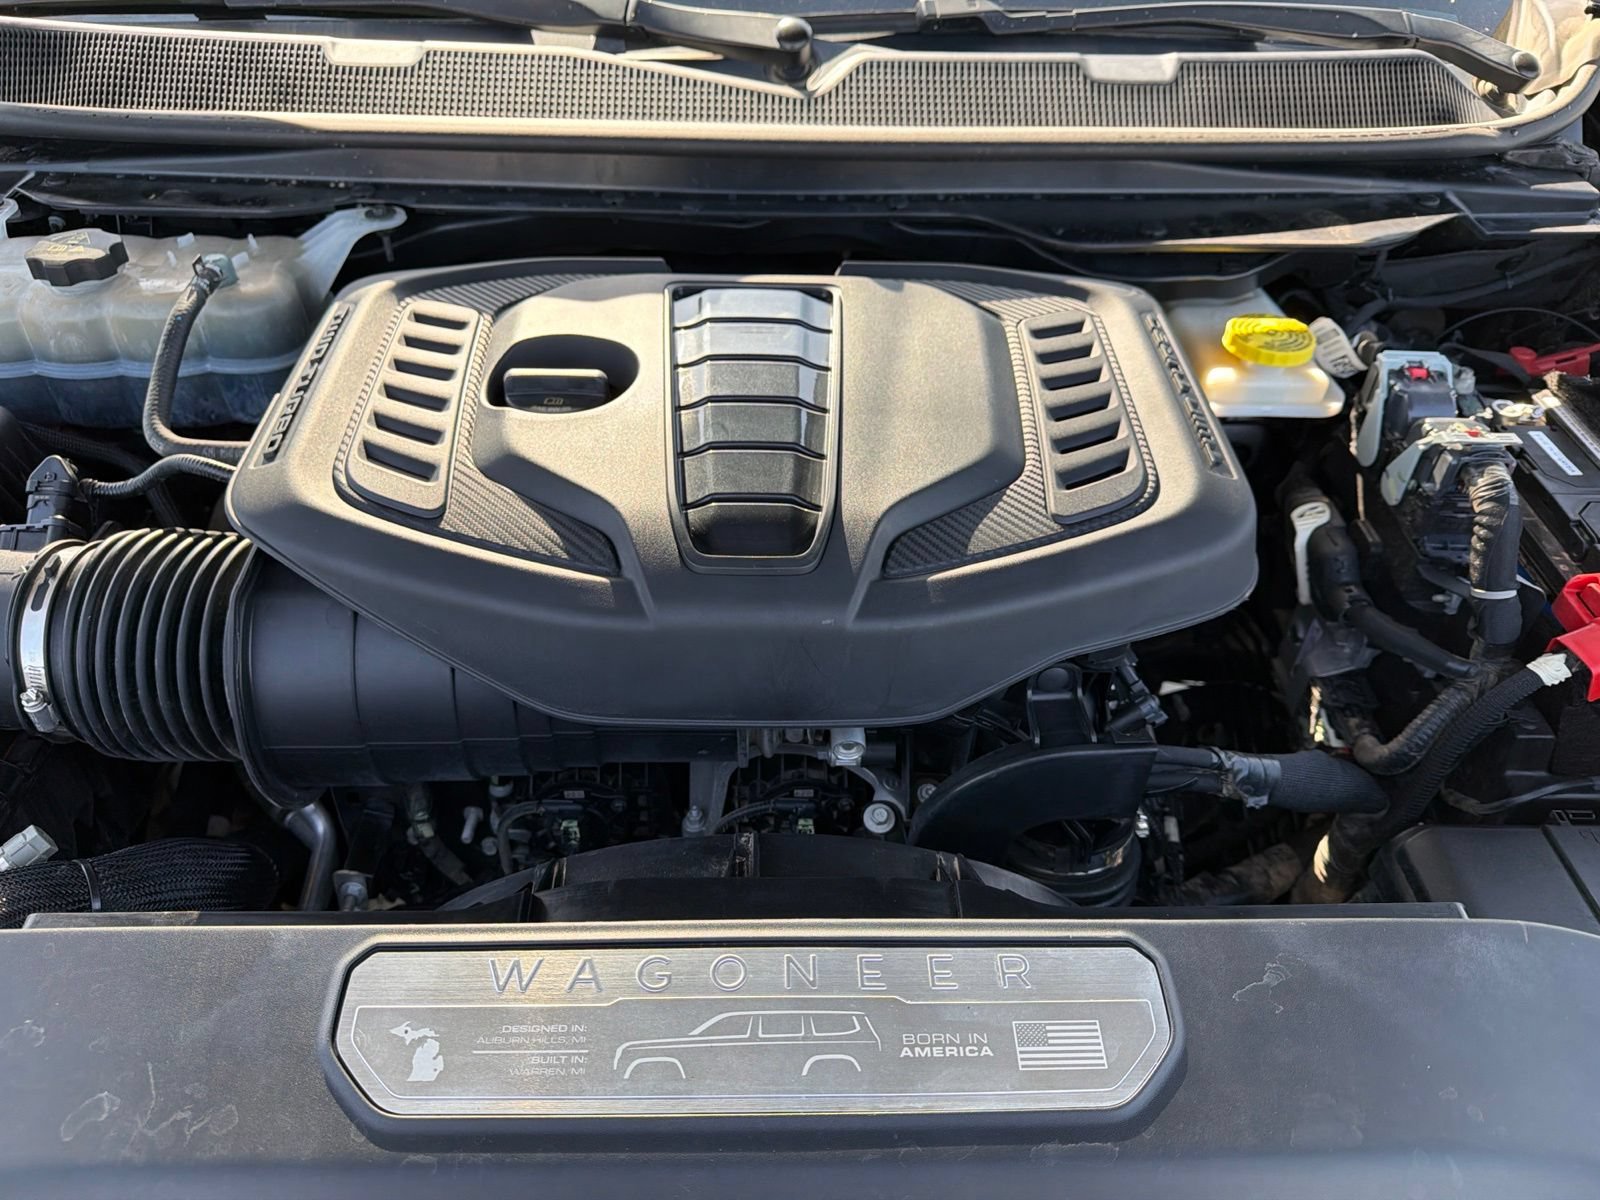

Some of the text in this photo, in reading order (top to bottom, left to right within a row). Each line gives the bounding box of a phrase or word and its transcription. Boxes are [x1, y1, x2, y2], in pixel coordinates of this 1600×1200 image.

[488, 953, 1032, 992] WAGONEER
[502, 1024, 588, 1033] DESIGNED IN:
[476, 1036, 530, 1045] AUBURN
[571, 1036, 587, 1044] MI
[902, 1032, 988, 1045] BORN IN
[899, 1046, 994, 1058] AMERICA
[530, 1055, 588, 1064] BUILT IN:
[570, 1067, 586, 1075] MI
